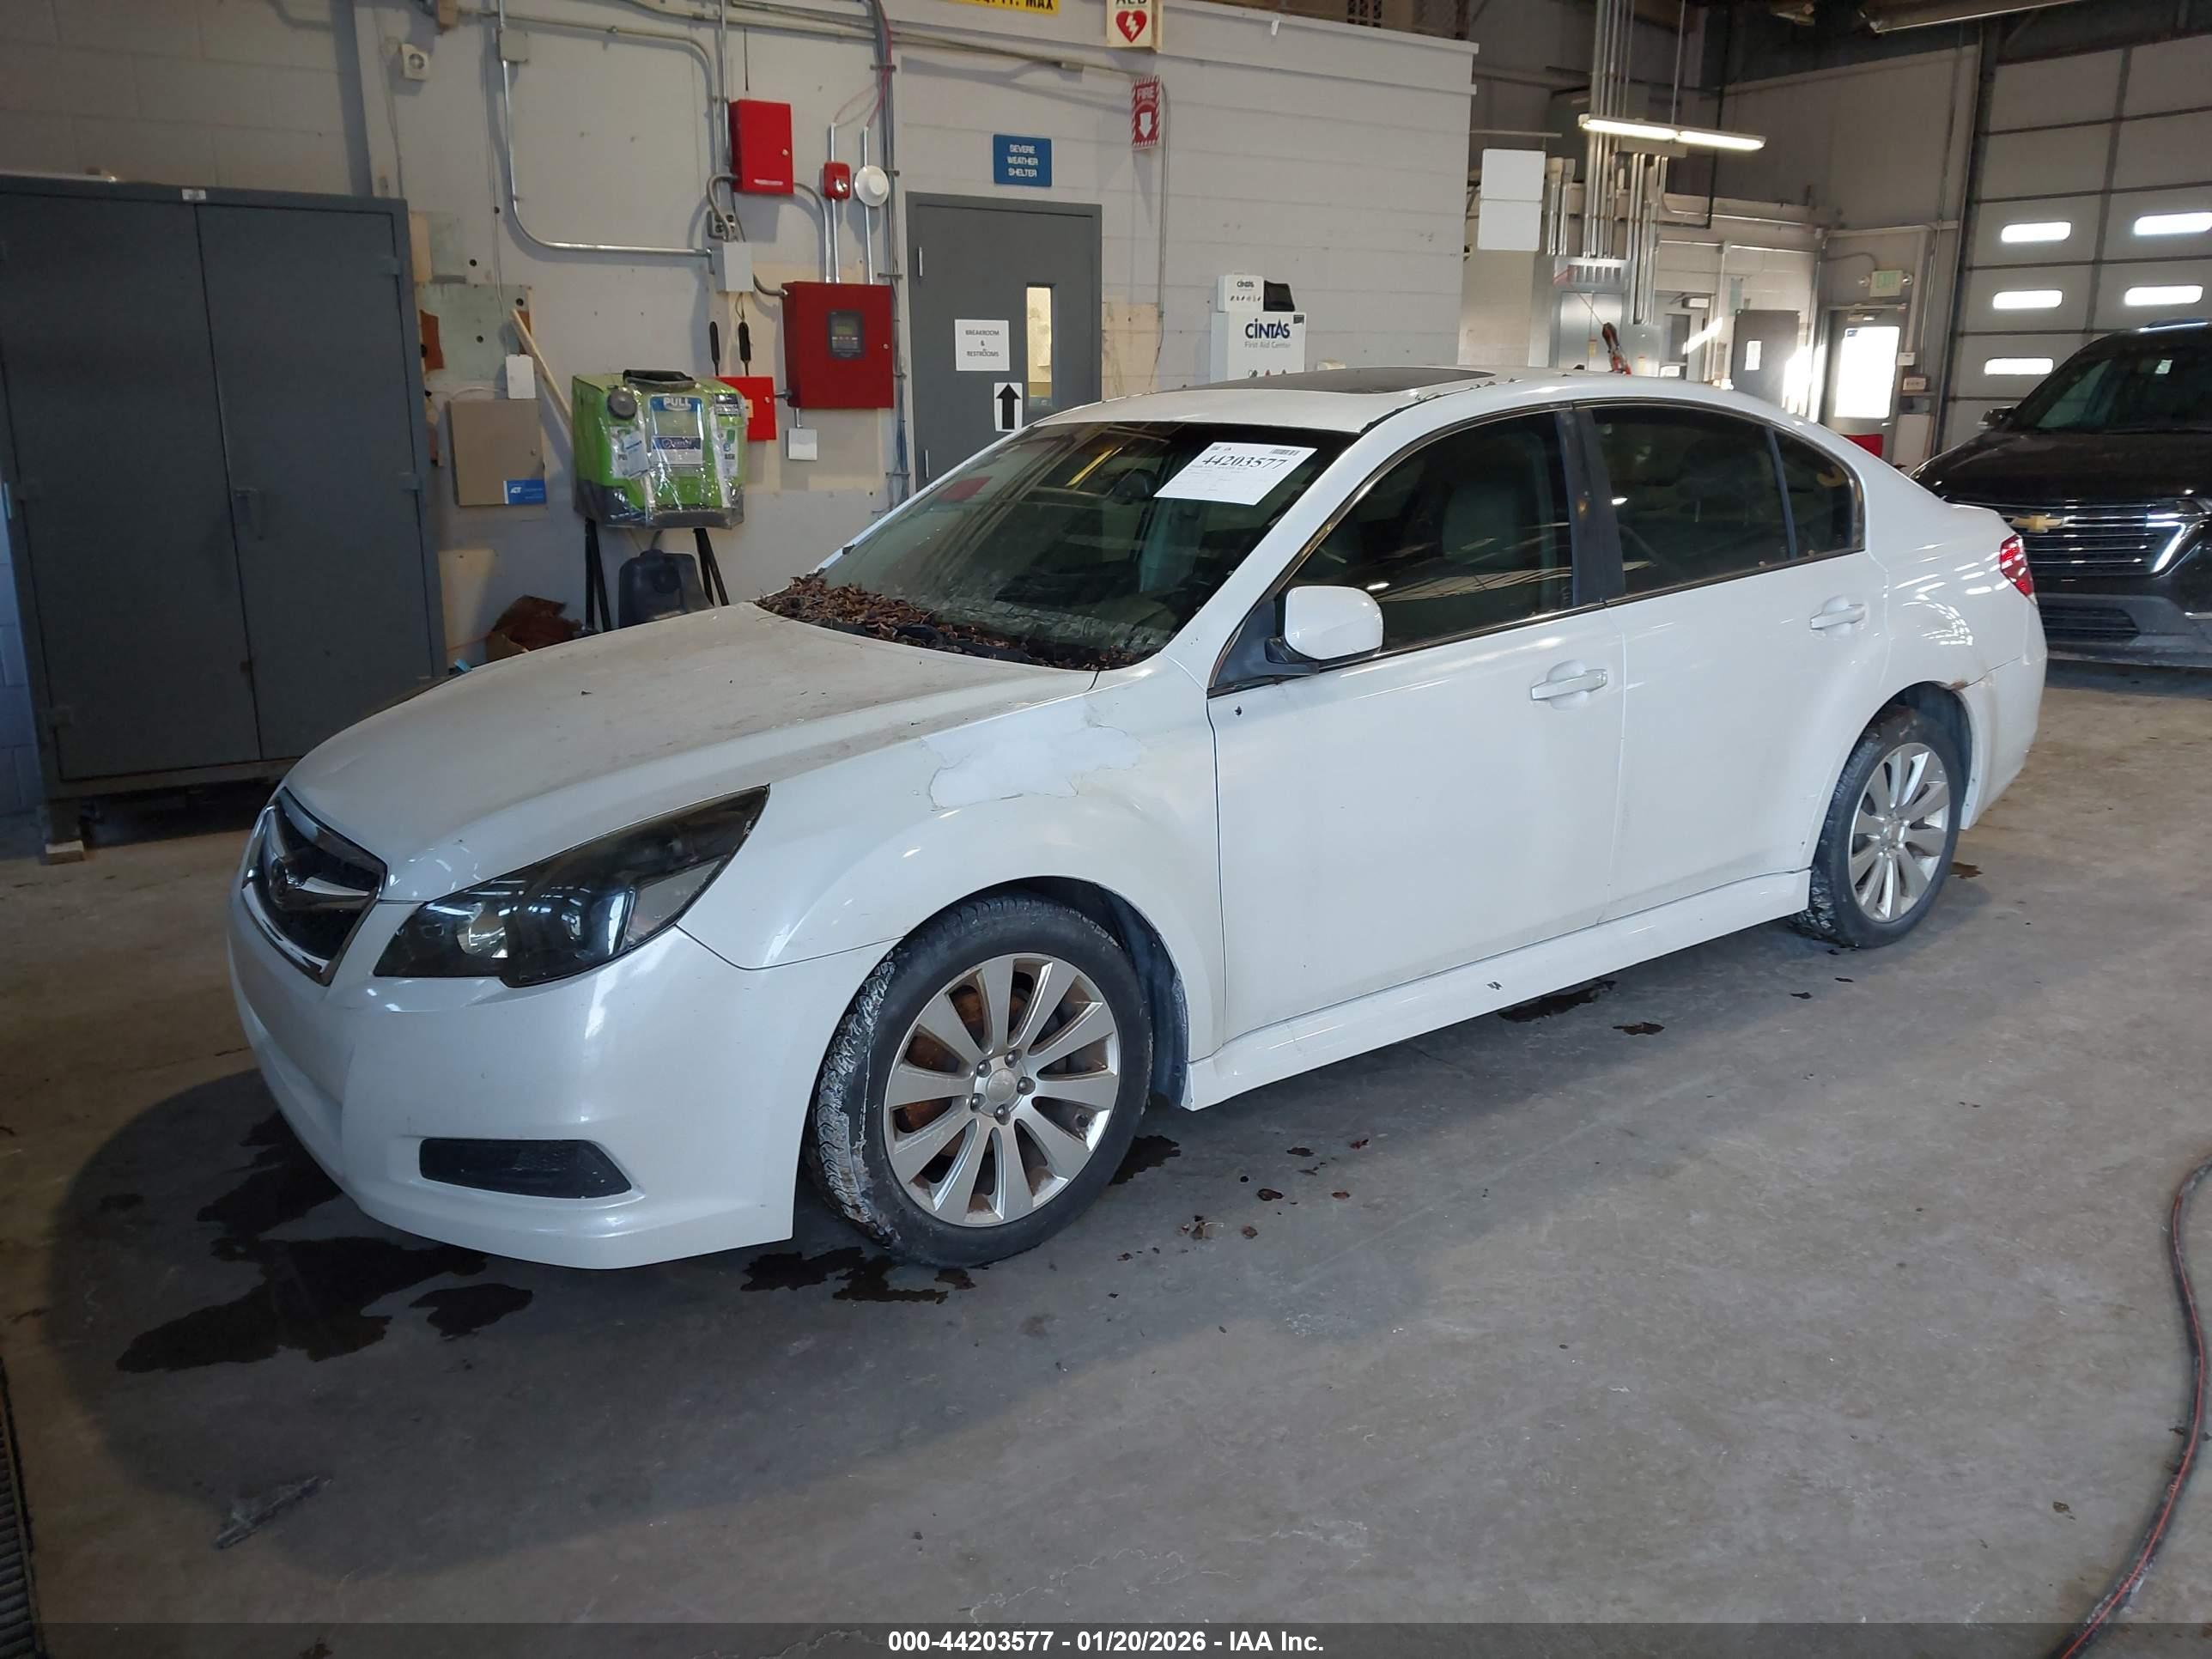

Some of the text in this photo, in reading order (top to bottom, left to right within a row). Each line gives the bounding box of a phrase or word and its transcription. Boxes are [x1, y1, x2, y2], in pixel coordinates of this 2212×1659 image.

[1136, 86, 1155, 102] FIRE
[1009, 143, 1036, 154] SEVERE
[1006, 155, 1039, 166] WEATHER
[1008, 167, 1037, 178] SHELTER
[663, 396, 691, 407] PULL
[1201, 454, 1288, 470] 44203577
